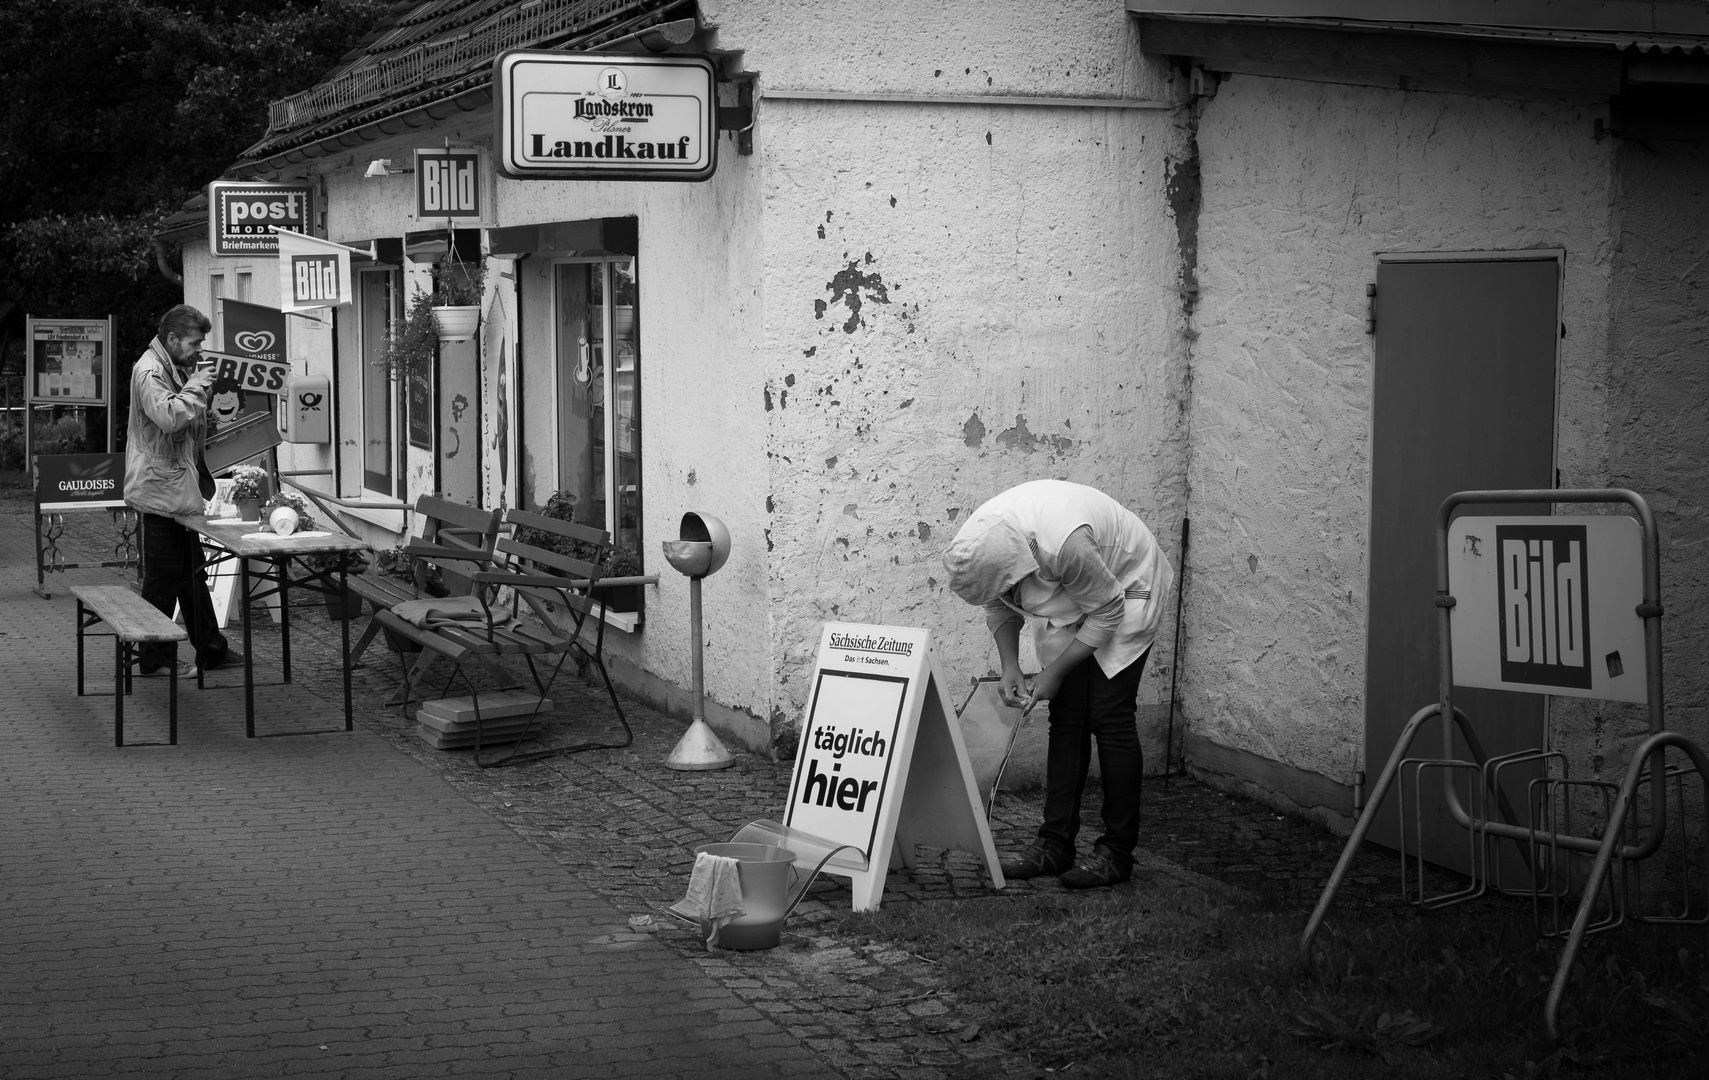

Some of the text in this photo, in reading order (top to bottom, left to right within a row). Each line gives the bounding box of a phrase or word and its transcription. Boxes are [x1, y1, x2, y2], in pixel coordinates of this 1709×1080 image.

[573, 98, 654, 120] Landskron
[591, 117, 632, 133] Pilsner
[531, 134, 690, 159] Landkauf
[424, 160, 475, 210] Bild
[231, 195, 299, 225] post
[222, 241, 279, 250] Briefmarkenv
[295, 260, 337, 300] Bild
[59, 479, 115, 491] GAULOISES
[1503, 540, 1584, 667] Bild
[829, 632, 914, 657] Sächsische Zeitung
[865, 657, 890, 665] Sachsen.
[814, 725, 886, 759] täglich
[802, 759, 878, 812] hier
